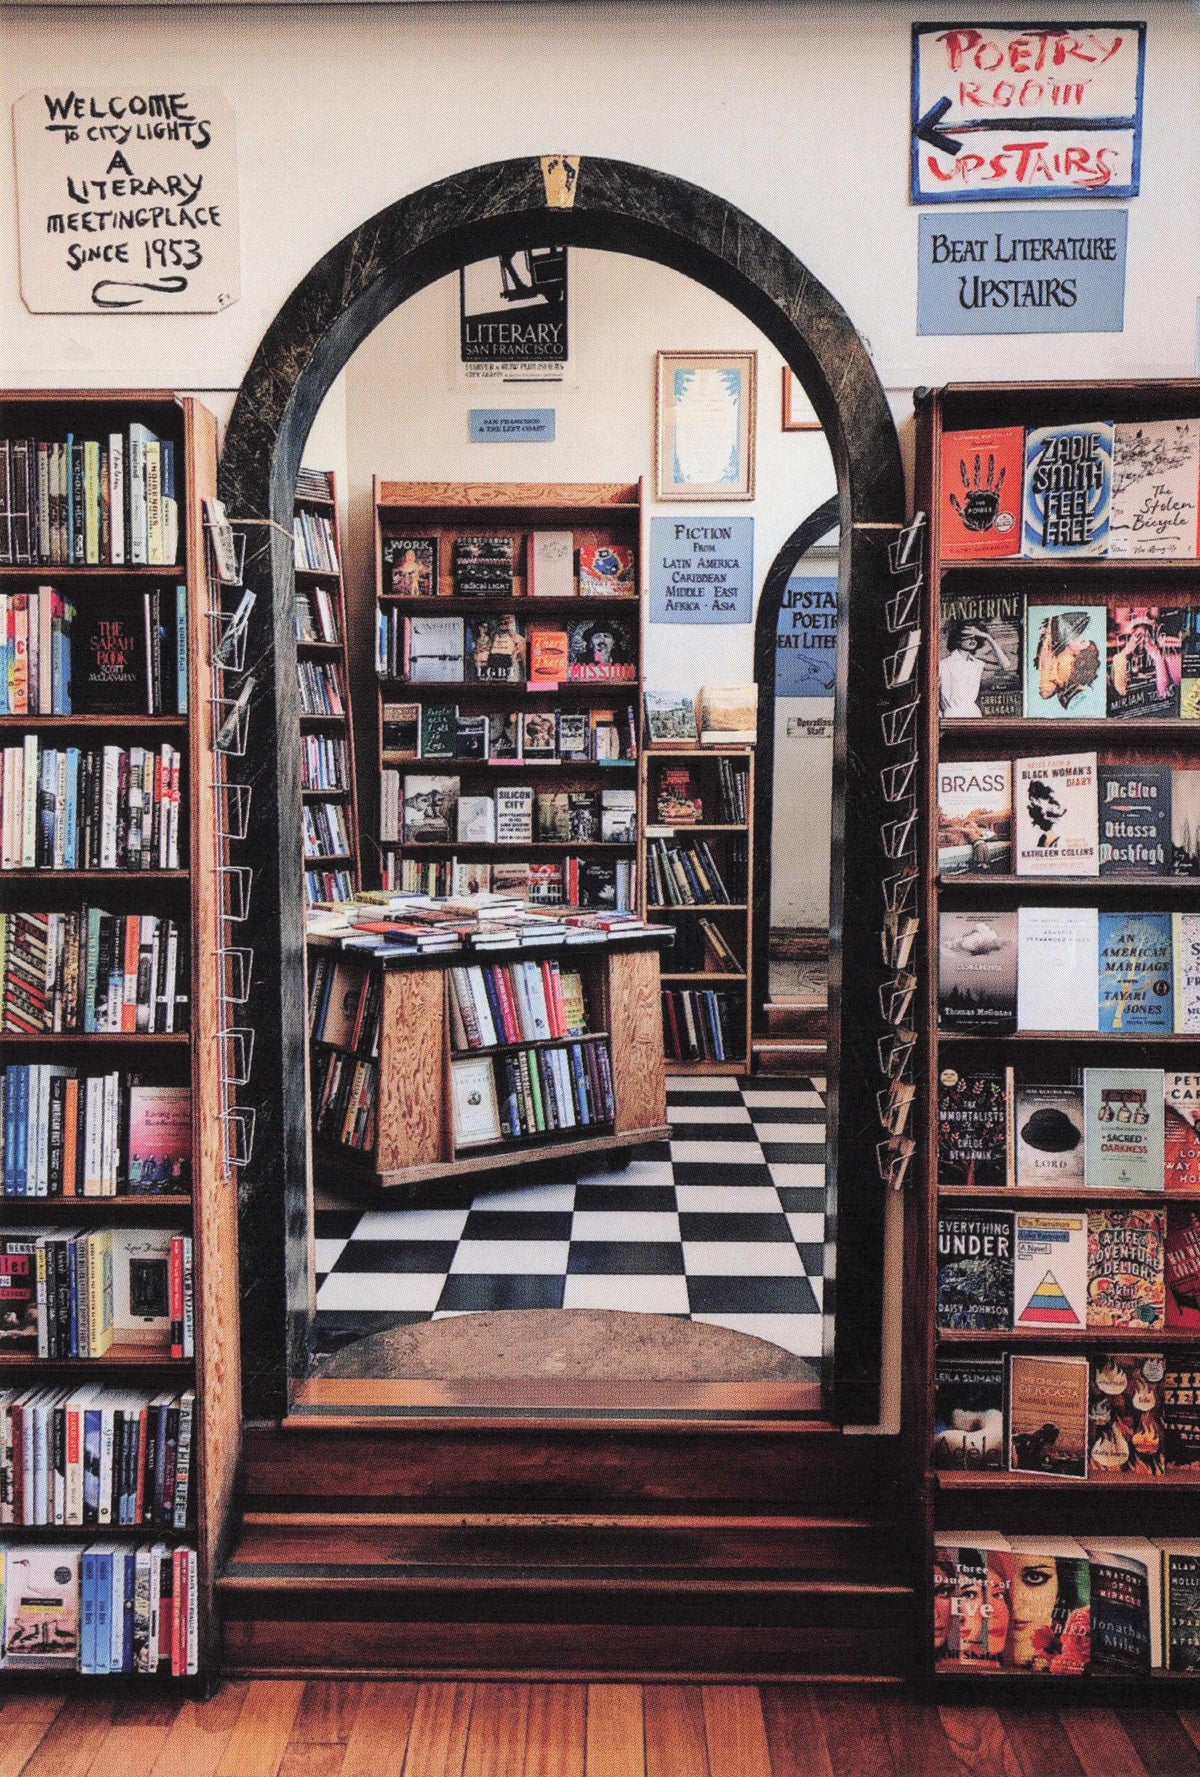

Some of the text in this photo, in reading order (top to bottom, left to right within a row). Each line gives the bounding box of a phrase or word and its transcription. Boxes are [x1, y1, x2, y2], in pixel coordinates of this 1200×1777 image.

[936, 29, 1123, 73] POETRY
[959, 77, 1091, 107] ROOM
[44, 91, 196, 121] WELCOME
[106, 150, 134, 176] A
[928, 141, 1119, 189] UPSTAIRS
[67, 173, 203, 206] LITERARY
[66, 239, 203, 271] SINCE 1953
[931, 233, 1117, 264] BEAT LITERATURE
[958, 276, 1077, 309] UPSTAIRS
[465, 323, 563, 343] LITERARY
[466, 343, 563, 355] SAN FRANCISCO
[1040, 433, 1102, 464] ZADIE
[1035, 462, 1104, 492] SMITH
[1152, 485, 1173, 498] The
[1044, 492, 1095, 518] FEEL
[1141, 497, 1195, 515] Stolen
[1132, 511, 1188, 533] Bicycle
[674, 525, 731, 539] FICTION
[1043, 517, 1094, 544] FREE
[391, 540, 428, 550] WORK
[693, 542, 715, 552] FROM
[663, 558, 740, 569] LATIN AMERICA
[672, 572, 727, 583] CARIBBEAN
[665, 586, 738, 597] MIDDLE EAST
[665, 600, 736, 611] AFRICA ASIA
[781, 591, 838, 608] UPSTA
[941, 597, 1019, 621] TANGERINE
[98, 622, 124, 637] THE
[776, 635, 799, 648] EAT
[571, 664, 635, 680] MISSION
[1021, 766, 1092, 780] BLACK WOMAN'S
[941, 775, 1005, 793] BRASS
[1066, 777, 1092, 787] DIARY
[499, 791, 531, 799] SILICON
[504, 800, 524, 808] CITY
[1105, 821, 1158, 838] Ottessa
[1021, 847, 1094, 859] KATHLEEN COLLINS
[1117, 934, 1134, 943] AN
[1101, 946, 1167, 957] AMERICAN
[1104, 961, 1169, 972] MARRIAGE
[1104, 990, 1146, 1000] TAYARI
[1123, 1005, 1163, 1015] JONES
[1106, 1134, 1142, 1143] SACRED
[1101, 1143, 1148, 1154] DARKNESS
[1035, 1159, 1067, 1168] LORD
[938, 1221, 1010, 1235] EVERYTHING
[1113, 1230, 1139, 1244] LIFE
[938, 1236, 1009, 1257] UNDER
[938, 1303, 1009, 1315] DAISY JOHNSON
[1035, 1386, 1079, 1398] JOCASTA
[955, 1564, 988, 1574] Three
[1171, 1562, 1196, 1571] ALAN
[934, 1575, 1011, 1589] Daughters of
[1098, 1569, 1142, 1586] ANATOMY
[1099, 1590, 1142, 1607] MIRACLE
[950, 1597, 995, 1618] Eve
[1092, 1616, 1148, 1643] Jonathan
[1104, 1635, 1141, 1655] Miles
